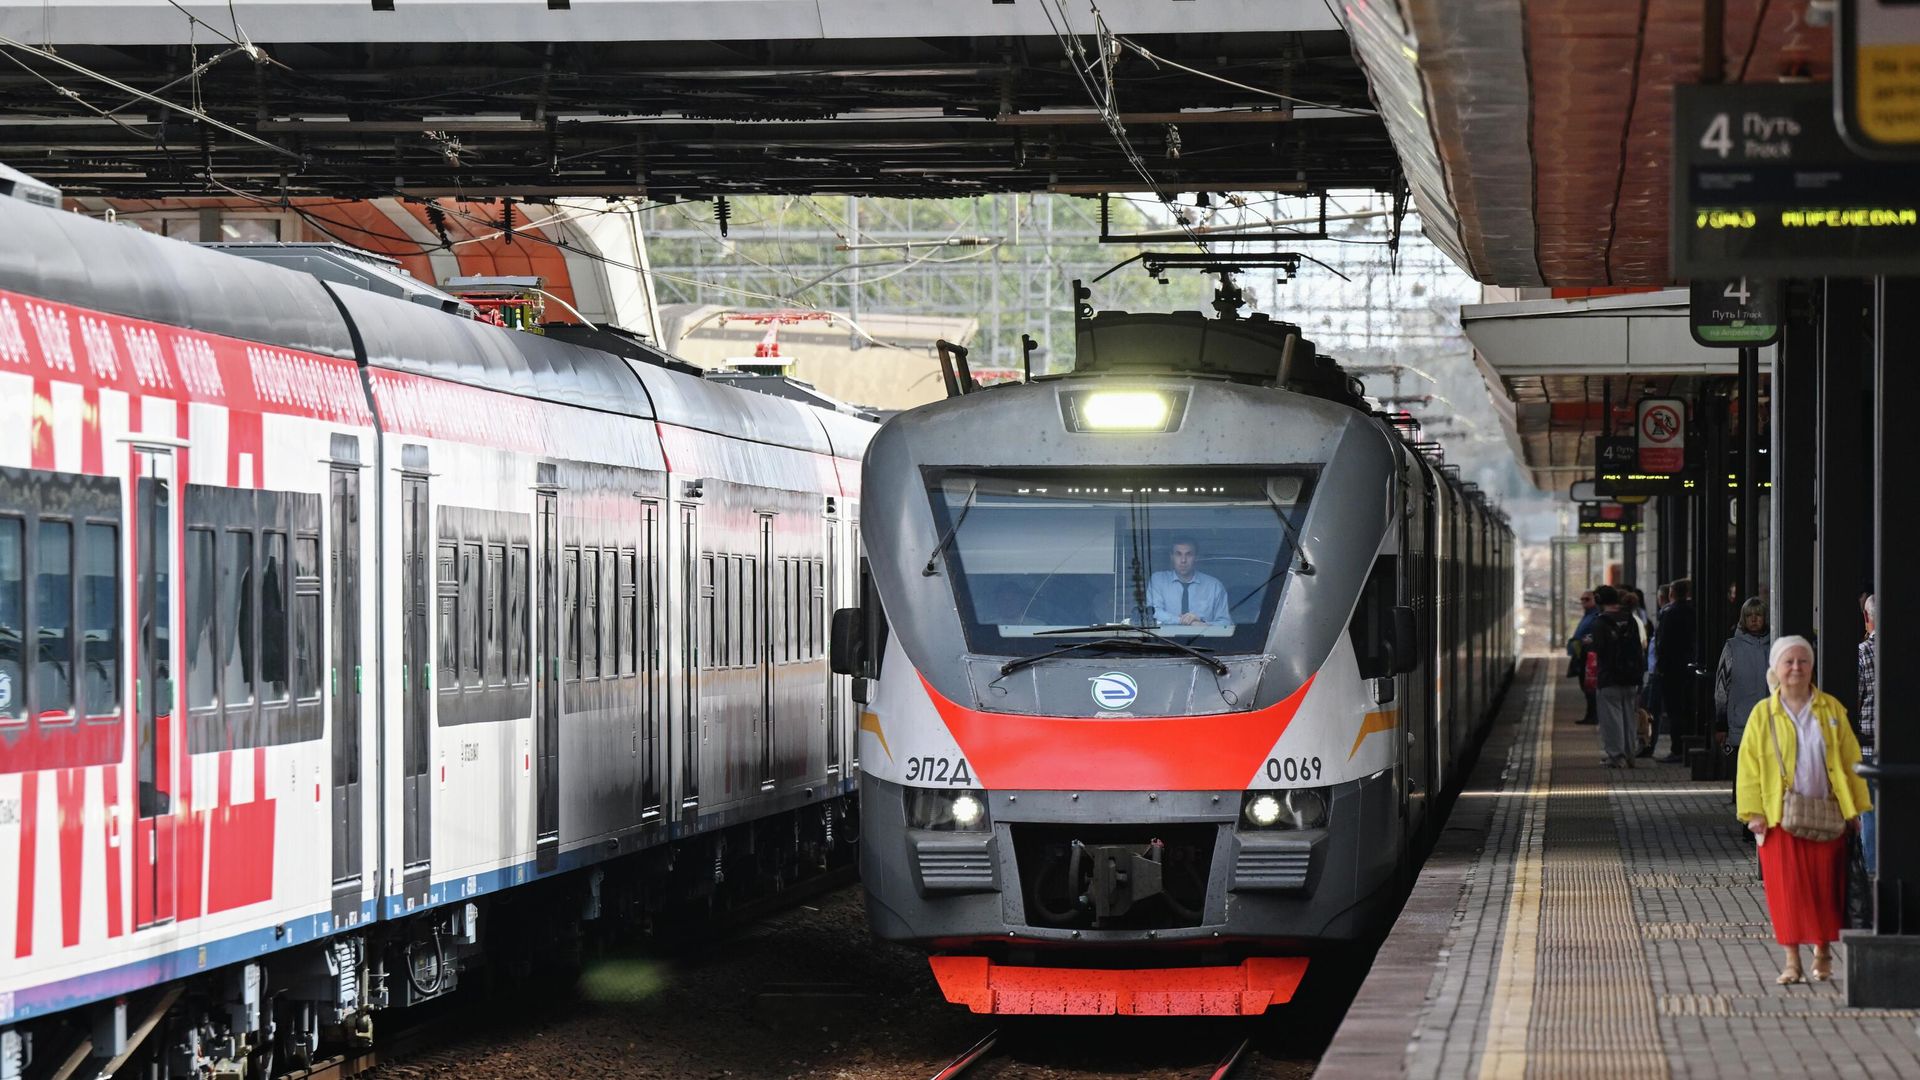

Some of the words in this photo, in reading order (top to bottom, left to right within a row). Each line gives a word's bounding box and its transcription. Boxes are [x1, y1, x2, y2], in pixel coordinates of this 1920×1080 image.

[1701, 113, 1733, 158] 4
[1743, 113, 1801, 140] Путь
[1723, 276, 1750, 305] 4
[1712, 310, 1735, 320] Путь
[1603, 446, 1614, 459] 4
[905, 757, 972, 786] ЭП2Д
[1266, 757, 1322, 782] 0069
